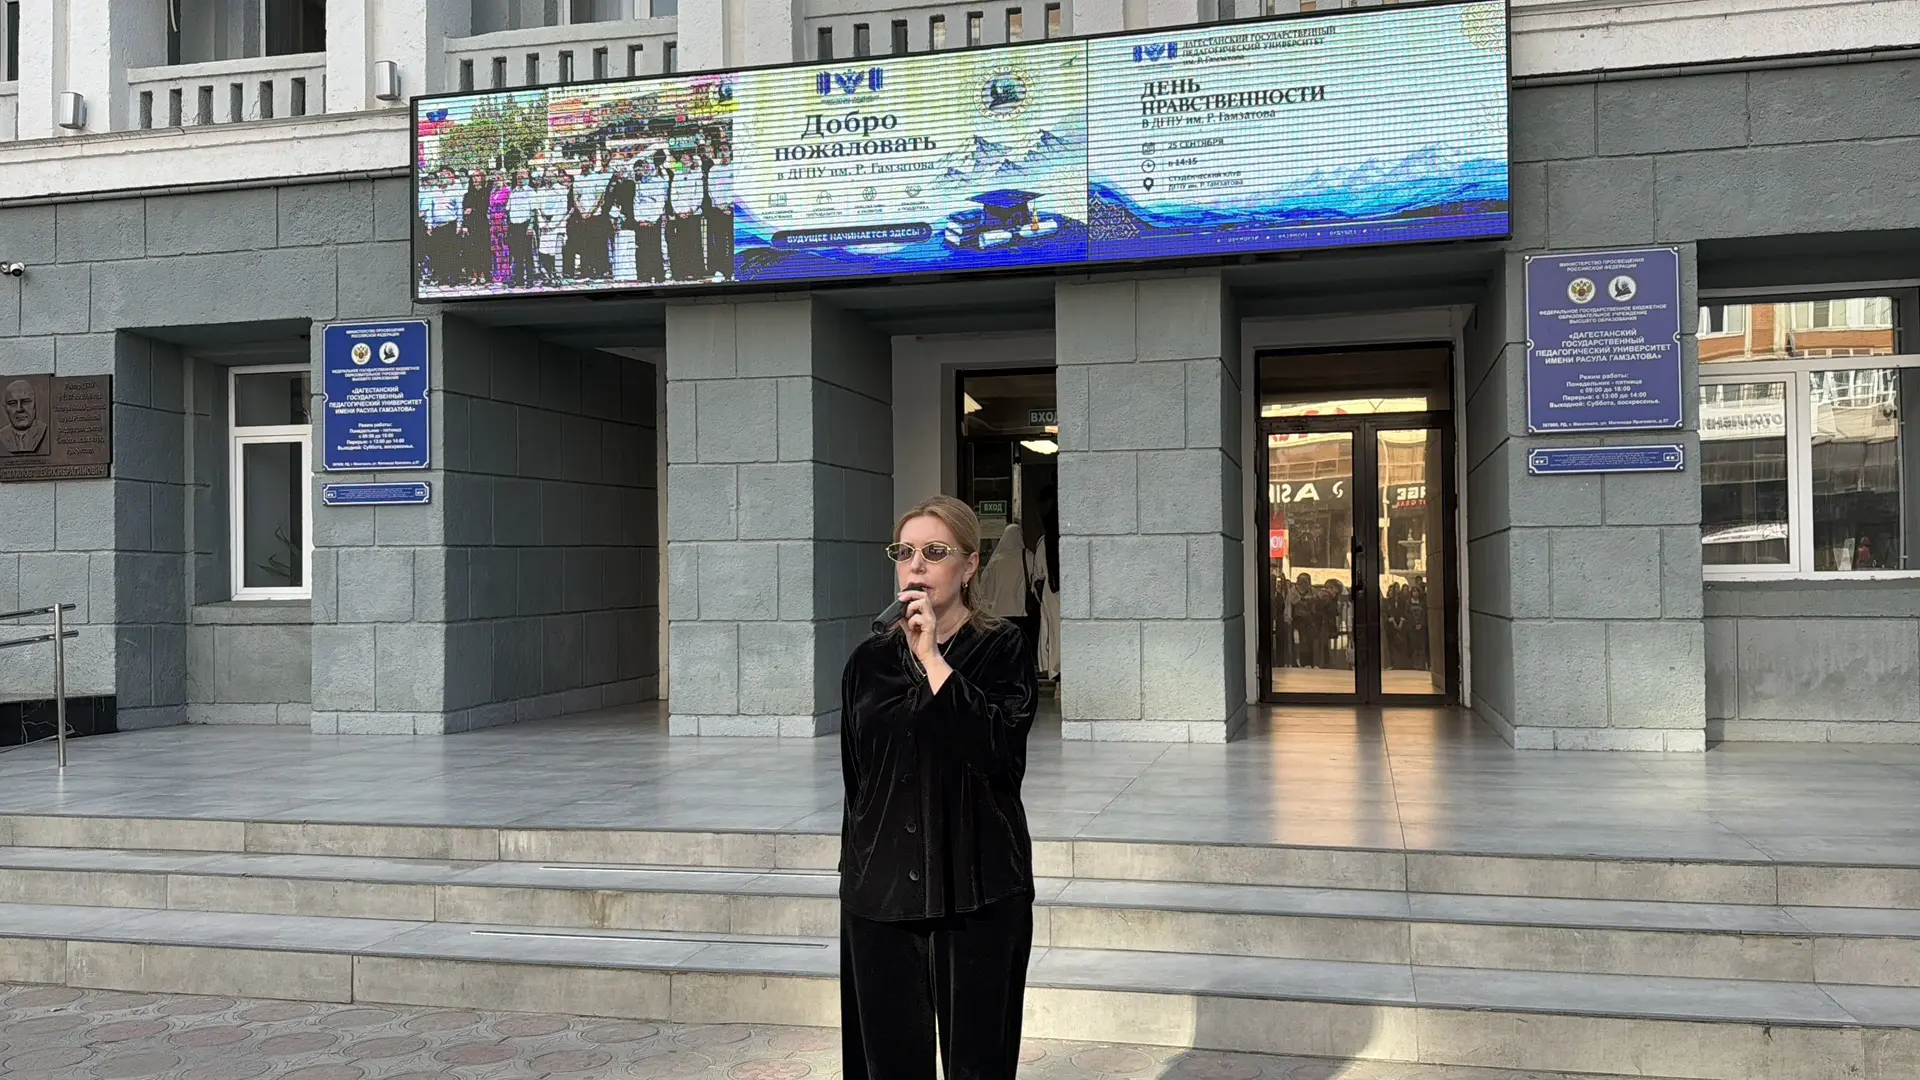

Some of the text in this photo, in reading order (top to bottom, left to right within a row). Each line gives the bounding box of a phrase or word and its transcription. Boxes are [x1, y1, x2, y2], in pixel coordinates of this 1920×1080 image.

[1182, 26, 1336, 48] ДАГЕСТАНСКИЙ ГОСУДАРСТВЕННЫЙ
[1141, 78, 1200, 100] ДЕНЬ
[1142, 86, 1325, 116] НРАВСТВЕННОСТИ
[800, 110, 898, 140] Добро
[1152, 116, 1183, 129] ДГПУ
[1186, 115, 1205, 126] им.
[1206, 112, 1216, 123] Р.
[1218, 110, 1276, 122] Гамзатова
[774, 134, 936, 162] пожаловать
[1179, 138, 1224, 148] СЕНТЯБРЯ
[1175, 156, 1198, 166] 14:15
[777, 160, 934, 180] в ДГПУ им. Р. Гамзатова
[786, 234, 828, 244] БУДУЩЕЕ
[830, 231, 888, 241] НАЧИНАЕТСЯ
[1569, 328, 1637, 339] «ДАГЕСТАНСКИЙ
[1562, 337, 1644, 348] ГОСУДАРСТВЕННЫЙ
[1536, 344, 1672, 357] ПЕДАГОГИЧЕСКИЙ УНИВЕРСИТЕТ
[1576, 355, 1608, 363] РАСУЛА
[1608, 353, 1662, 362] ГАМЗАТОВА»
[352, 386, 399, 394] «ДАГЕСТАНСКИЙ
[346, 392, 404, 400] ГОСУДАРСТВЕННЫЙ
[329, 400, 380, 408] ПЕДАГОГИЧЕСКИЙ
[1586, 400, 1616, 408] Суббота,
[984, 503, 1002, 512] ВХОД
